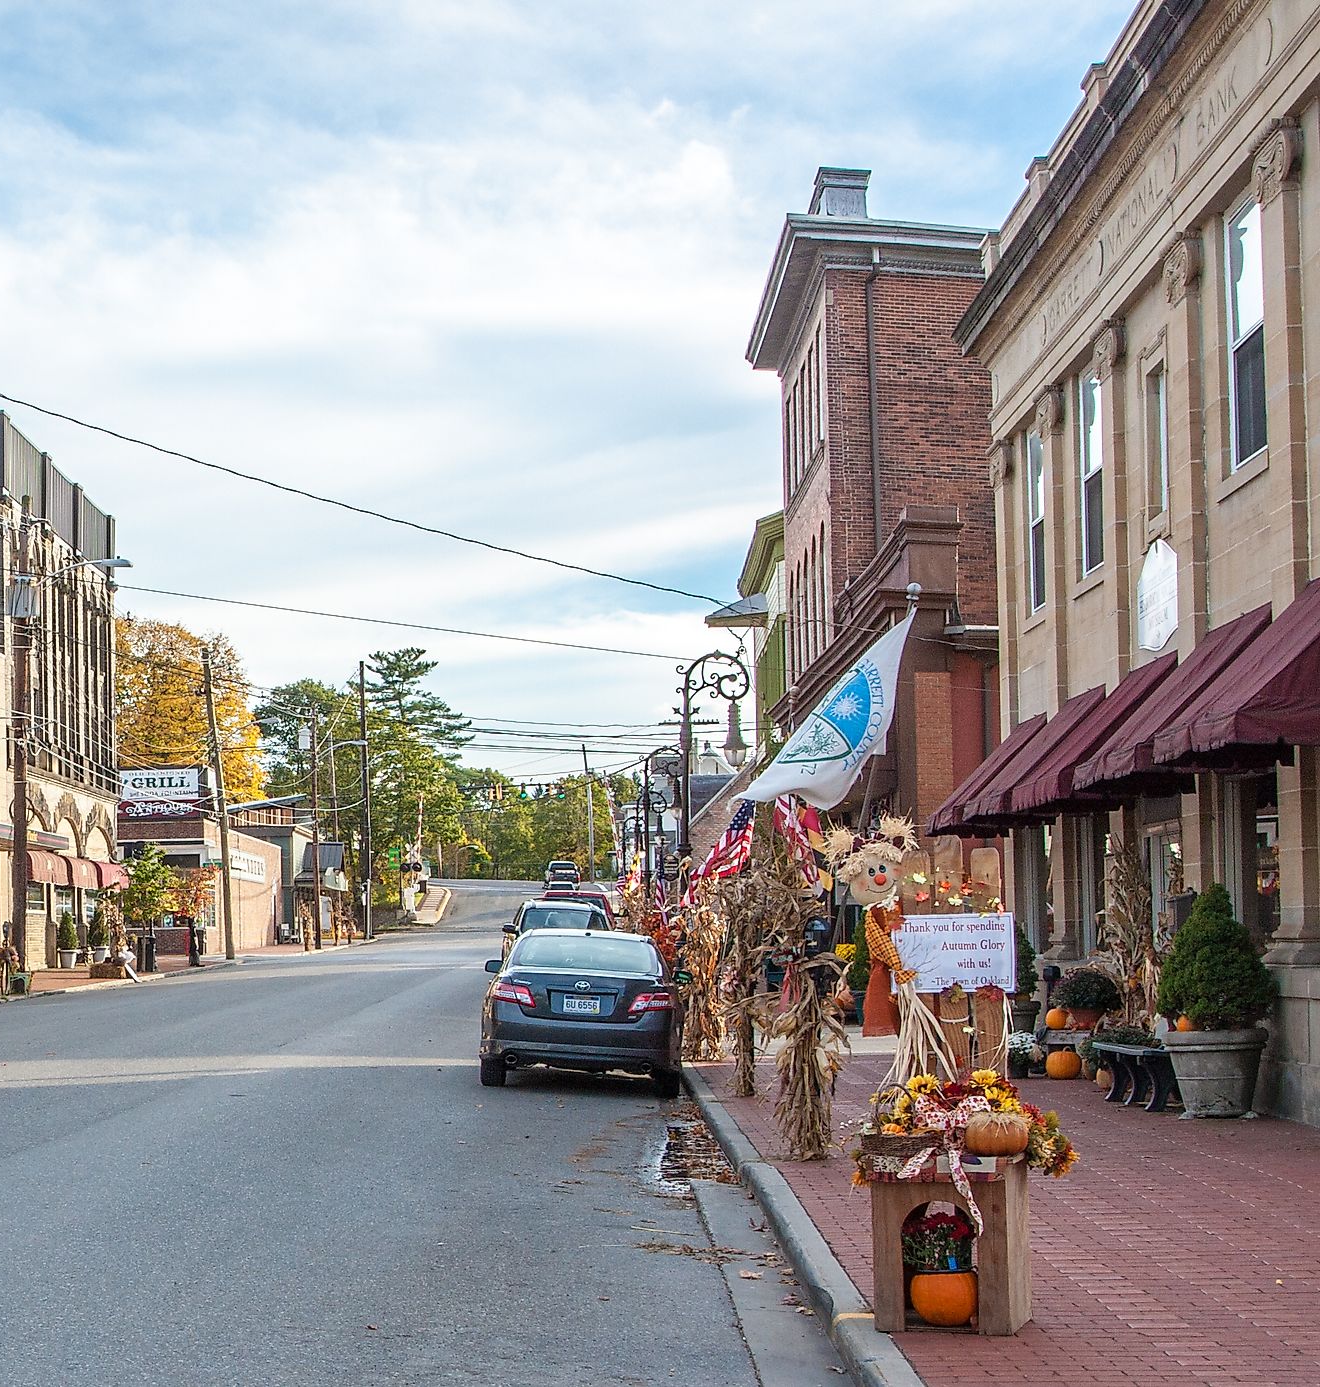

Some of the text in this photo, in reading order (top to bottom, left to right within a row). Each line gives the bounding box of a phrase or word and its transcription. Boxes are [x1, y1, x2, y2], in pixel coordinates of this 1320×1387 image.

[1106, 172, 1164, 254] NATIONAL
[1195, 65, 1239, 146] BANK
[842, 658, 885, 773] GARRETT COUNTY
[131, 776, 191, 789] GRILL
[904, 920, 1006, 934] Thank you for spending
[941, 939, 1006, 951] Autumn Glory
[957, 958, 992, 969] with us!
[951, 976, 971, 986] Town
[971, 976, 980, 985] of
[980, 975, 1010, 985] Oakland
[565, 1000, 598, 1010] 6U 6556
